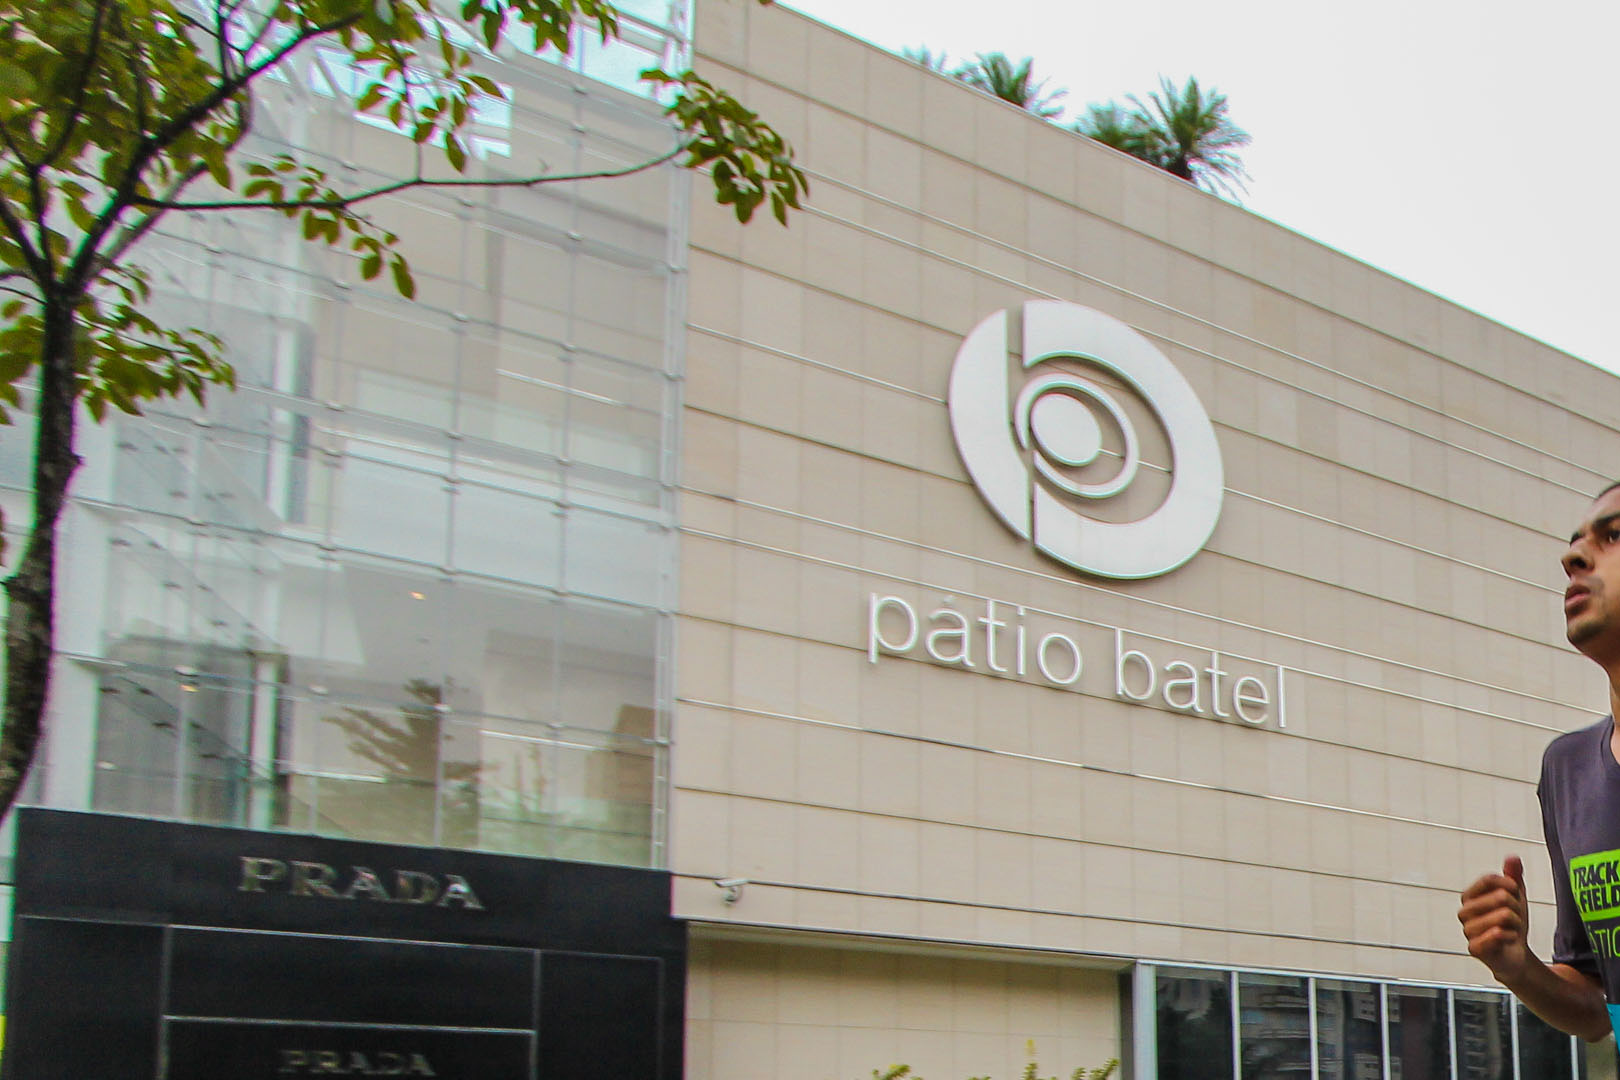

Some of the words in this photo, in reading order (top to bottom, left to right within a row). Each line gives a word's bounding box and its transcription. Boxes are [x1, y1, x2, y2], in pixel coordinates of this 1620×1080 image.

[1114, 627, 1288, 729] batel
[237, 855, 487, 911] PRADA
[1573, 859, 1620, 889] TRACK
[276, 1048, 438, 1077] PRADA
